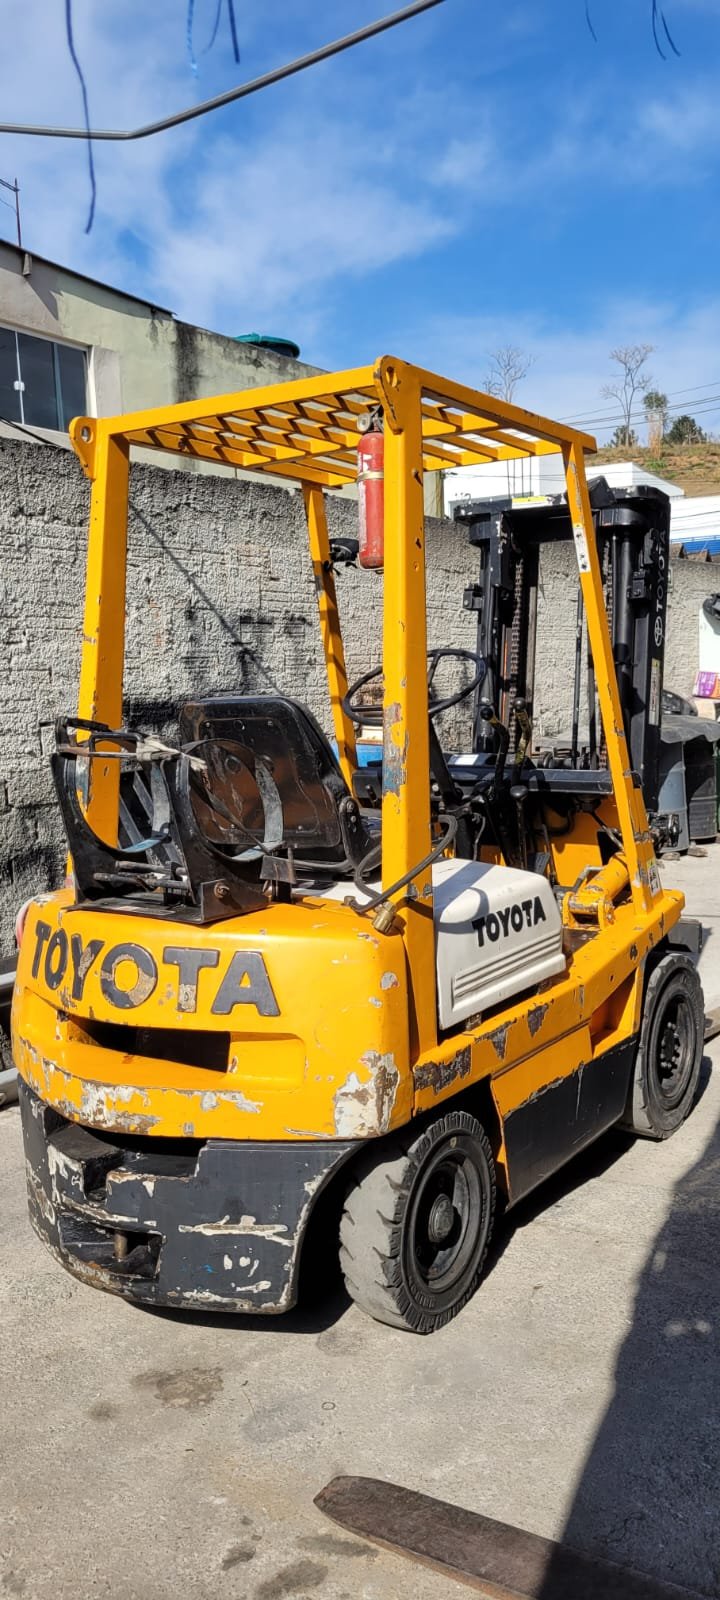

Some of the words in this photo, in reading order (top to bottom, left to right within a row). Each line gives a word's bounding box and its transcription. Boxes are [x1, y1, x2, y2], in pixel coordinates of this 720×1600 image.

[655, 529, 667, 612] TOYOTA
[472, 895, 547, 947] TOYOTA
[31, 919, 281, 1017] TOYOTA
